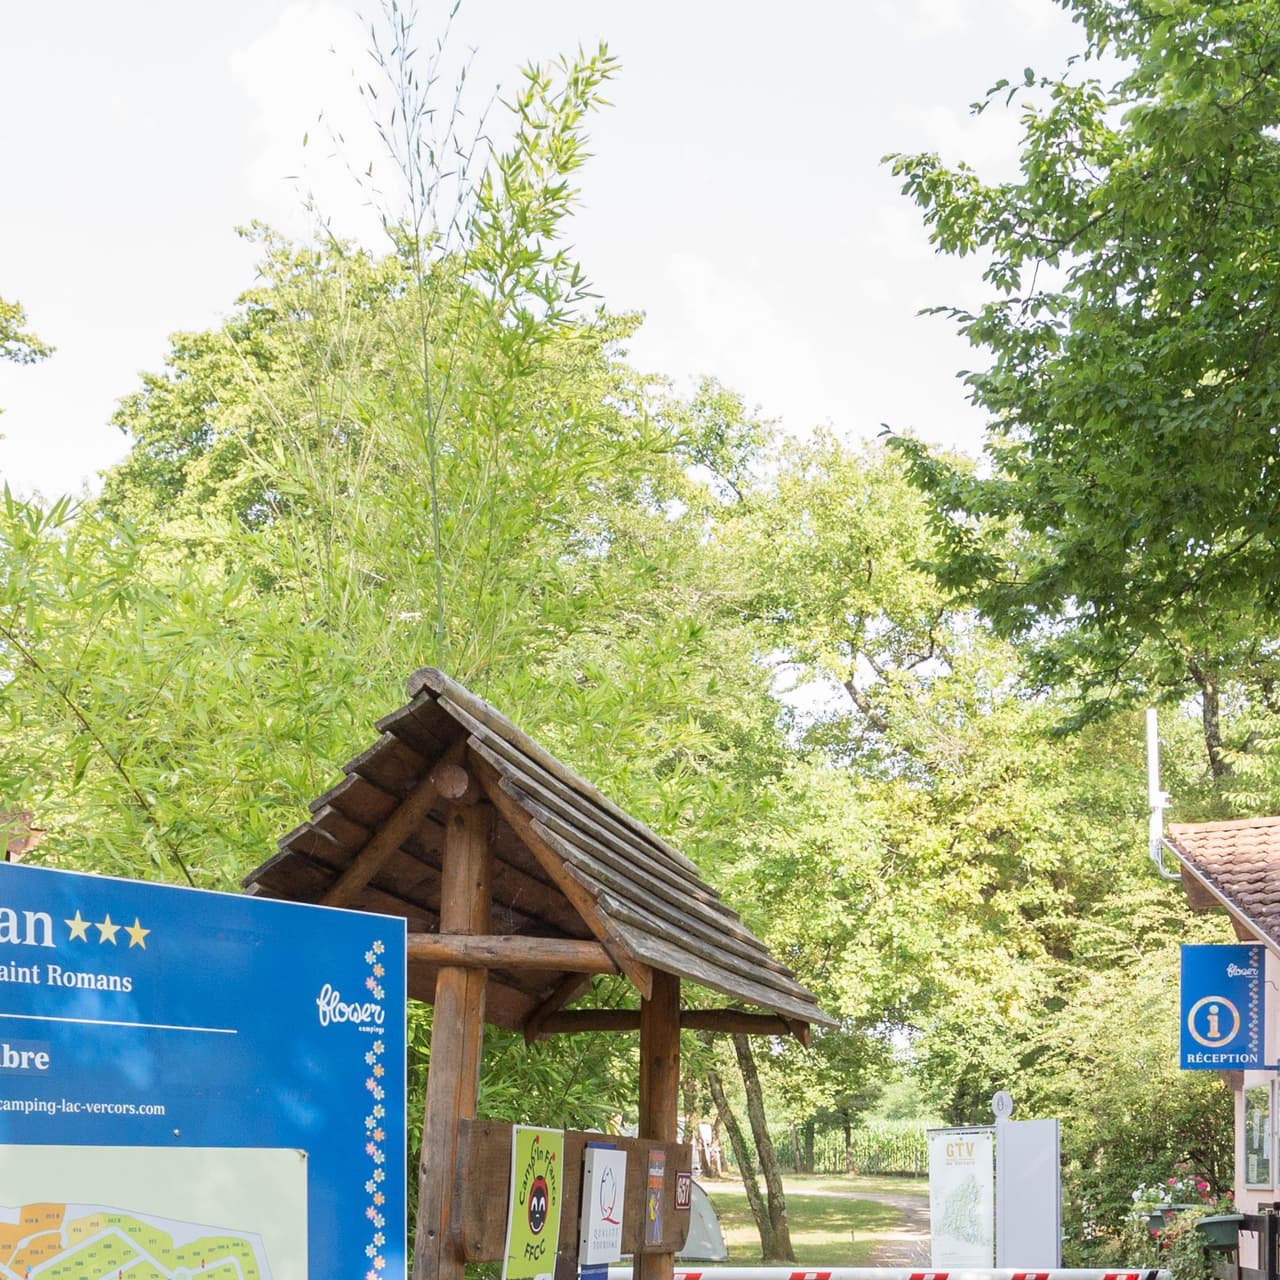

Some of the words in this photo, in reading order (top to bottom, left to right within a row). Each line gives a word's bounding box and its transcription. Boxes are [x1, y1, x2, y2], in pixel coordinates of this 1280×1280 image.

[47, 964, 133, 993] Romans
[316, 983, 385, 1027] flower
[1187, 1051, 1258, 1064] RÉCEPTION
